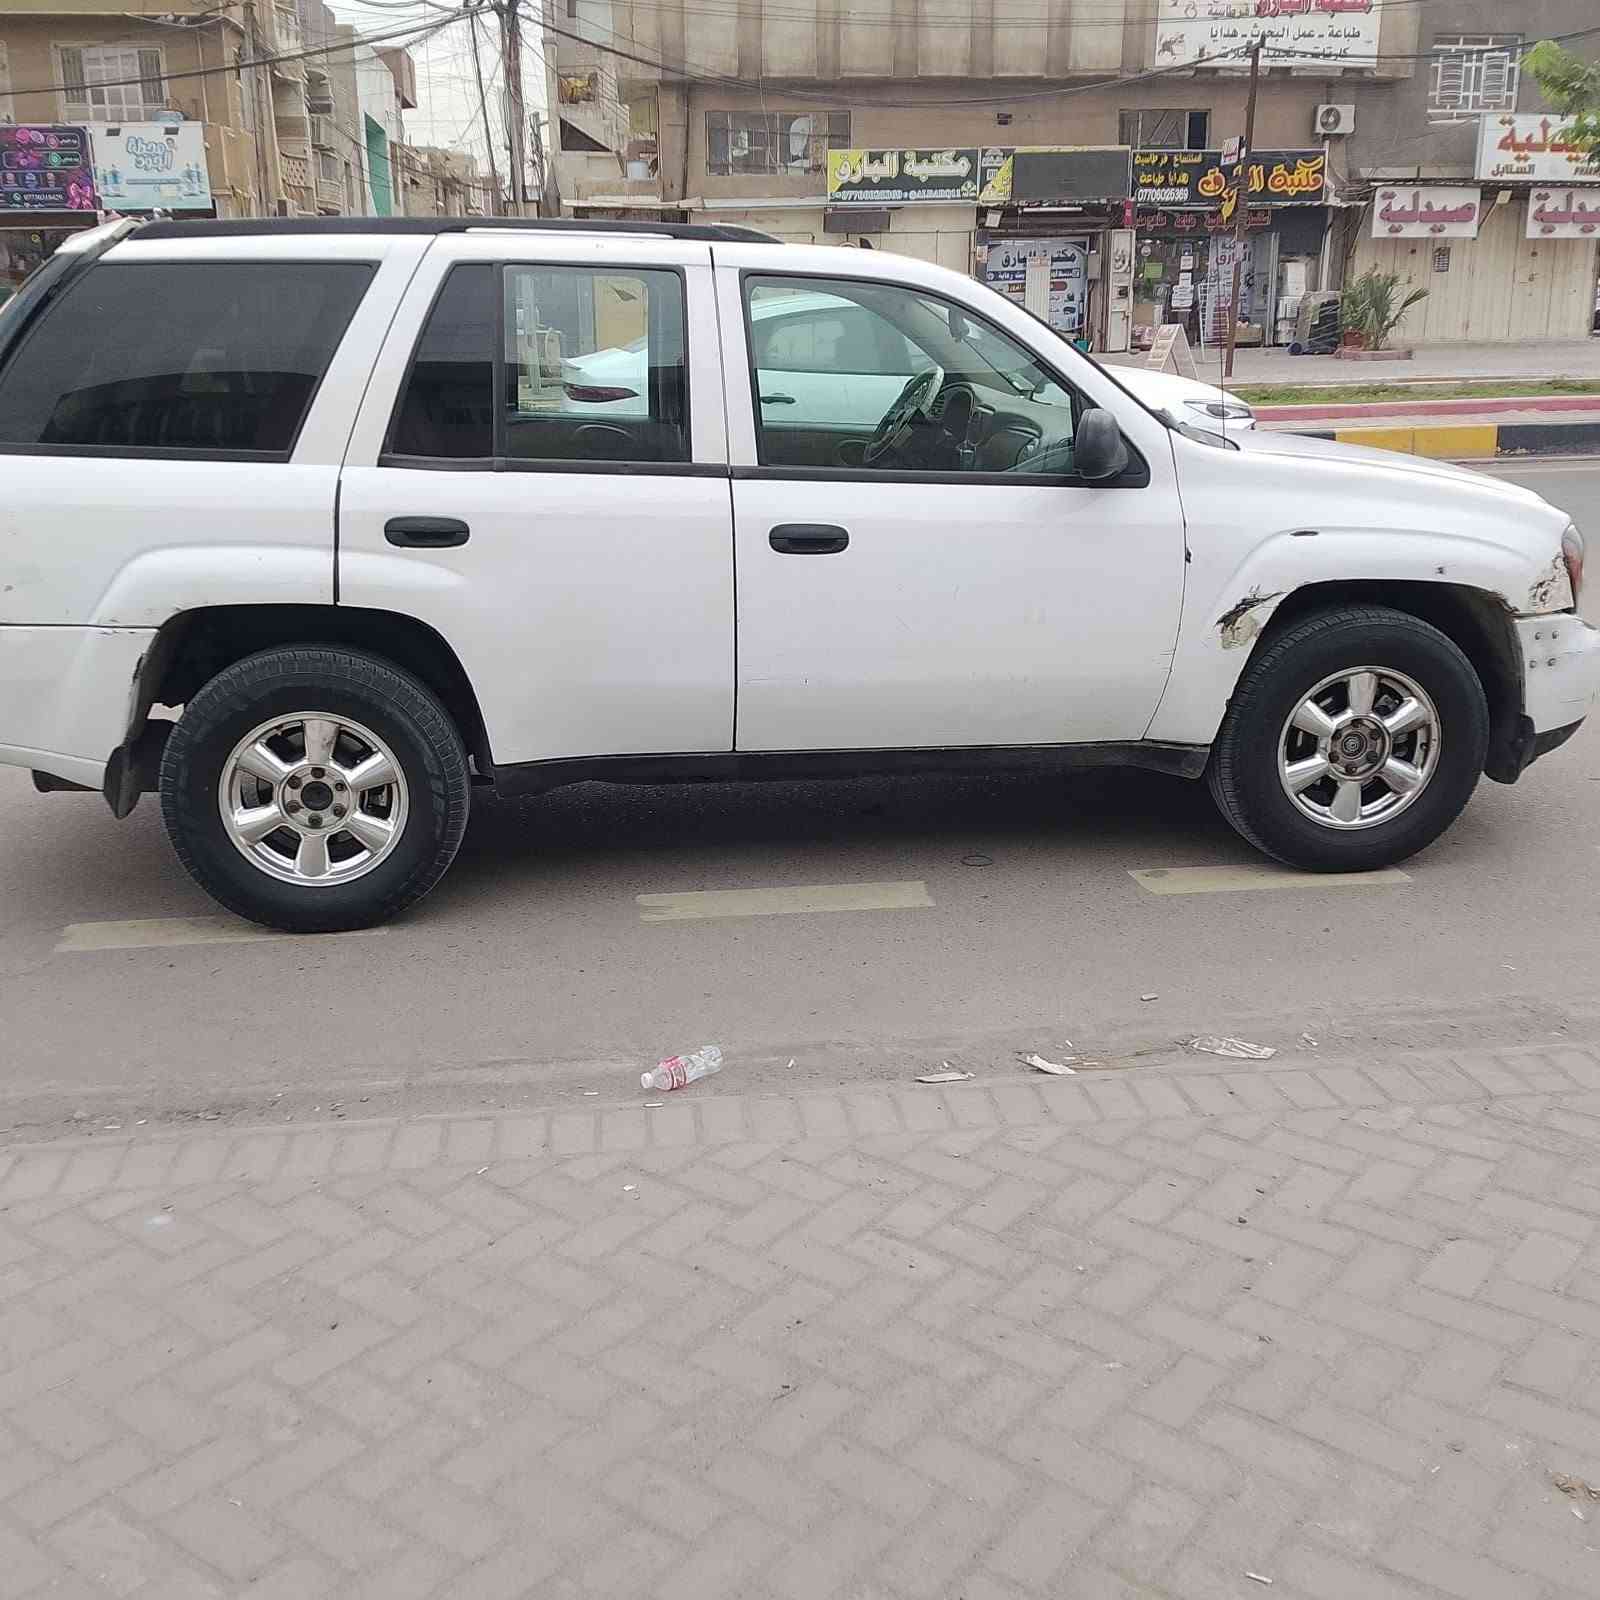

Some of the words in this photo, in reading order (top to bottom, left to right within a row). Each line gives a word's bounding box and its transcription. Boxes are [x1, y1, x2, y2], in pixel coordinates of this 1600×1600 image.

[1210, 24, 1238, 42] هدايا
[1293, 25, 1316, 41] عمل
[1328, 24, 1361, 42] طباعة
[835, 150, 899, 183] البارق
[904, 150, 971, 182] مكتبة
[1268, 153, 1324, 195] مكتبة
[1491, 163, 1536, 177] السنابل
[1379, 190, 1476, 234] صيدلية
[1534, 191, 1600, 234] يدلية
